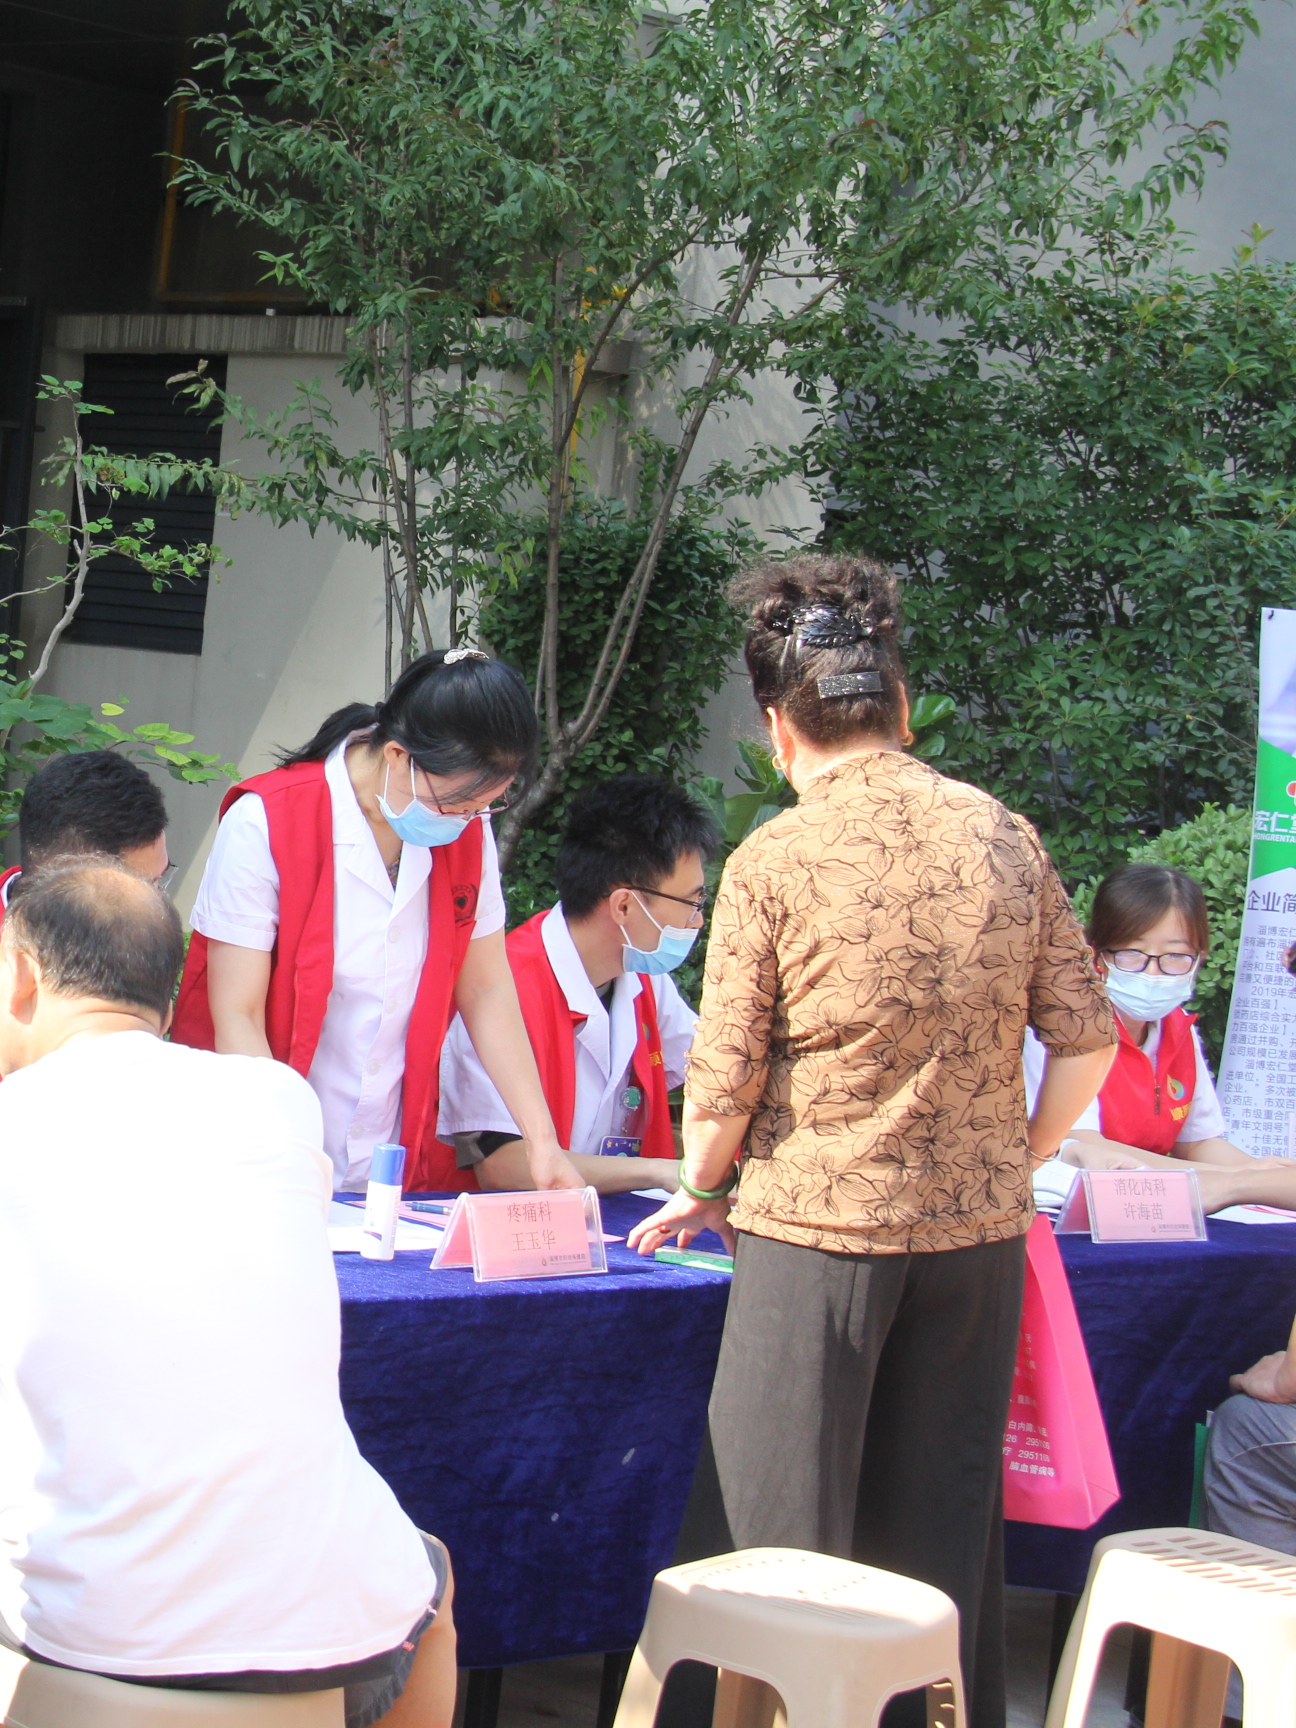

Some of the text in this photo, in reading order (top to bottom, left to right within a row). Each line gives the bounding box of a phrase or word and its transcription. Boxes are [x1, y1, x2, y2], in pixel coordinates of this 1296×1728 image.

[1114, 1178, 1166, 1196] 消化内科
[507, 1200, 552, 1223] 疼痛科
[1124, 1203, 1163, 1220] 许海苗
[510, 1230, 556, 1251] 王玉华
